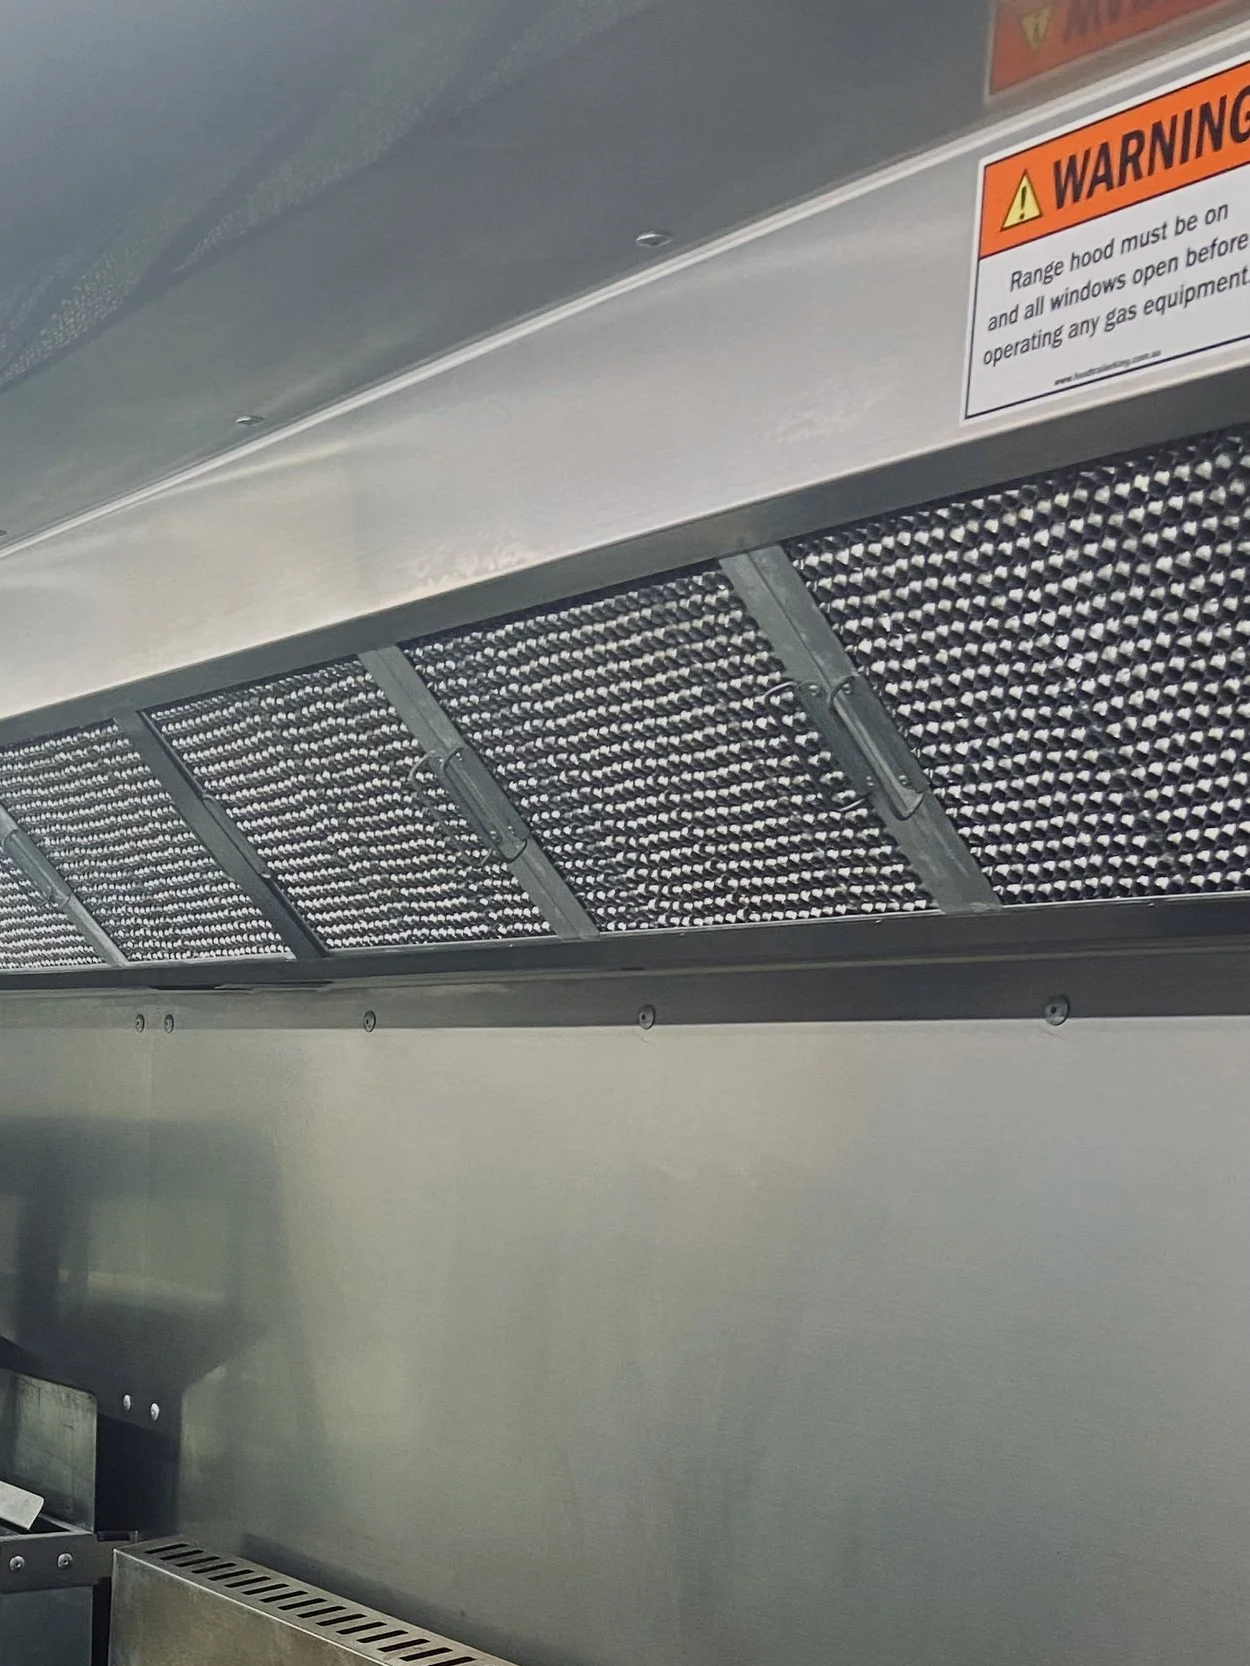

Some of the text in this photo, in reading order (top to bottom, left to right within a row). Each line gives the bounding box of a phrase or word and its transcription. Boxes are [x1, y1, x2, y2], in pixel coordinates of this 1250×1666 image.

[1053, 85, 1250, 210] WARNING
[988, 232, 1250, 332] and all windows open before
[1010, 203, 1229, 292] Range hood must be on
[983, 324, 1064, 368] operating
[1068, 315, 1100, 338] any
[1104, 303, 1137, 333] gas
